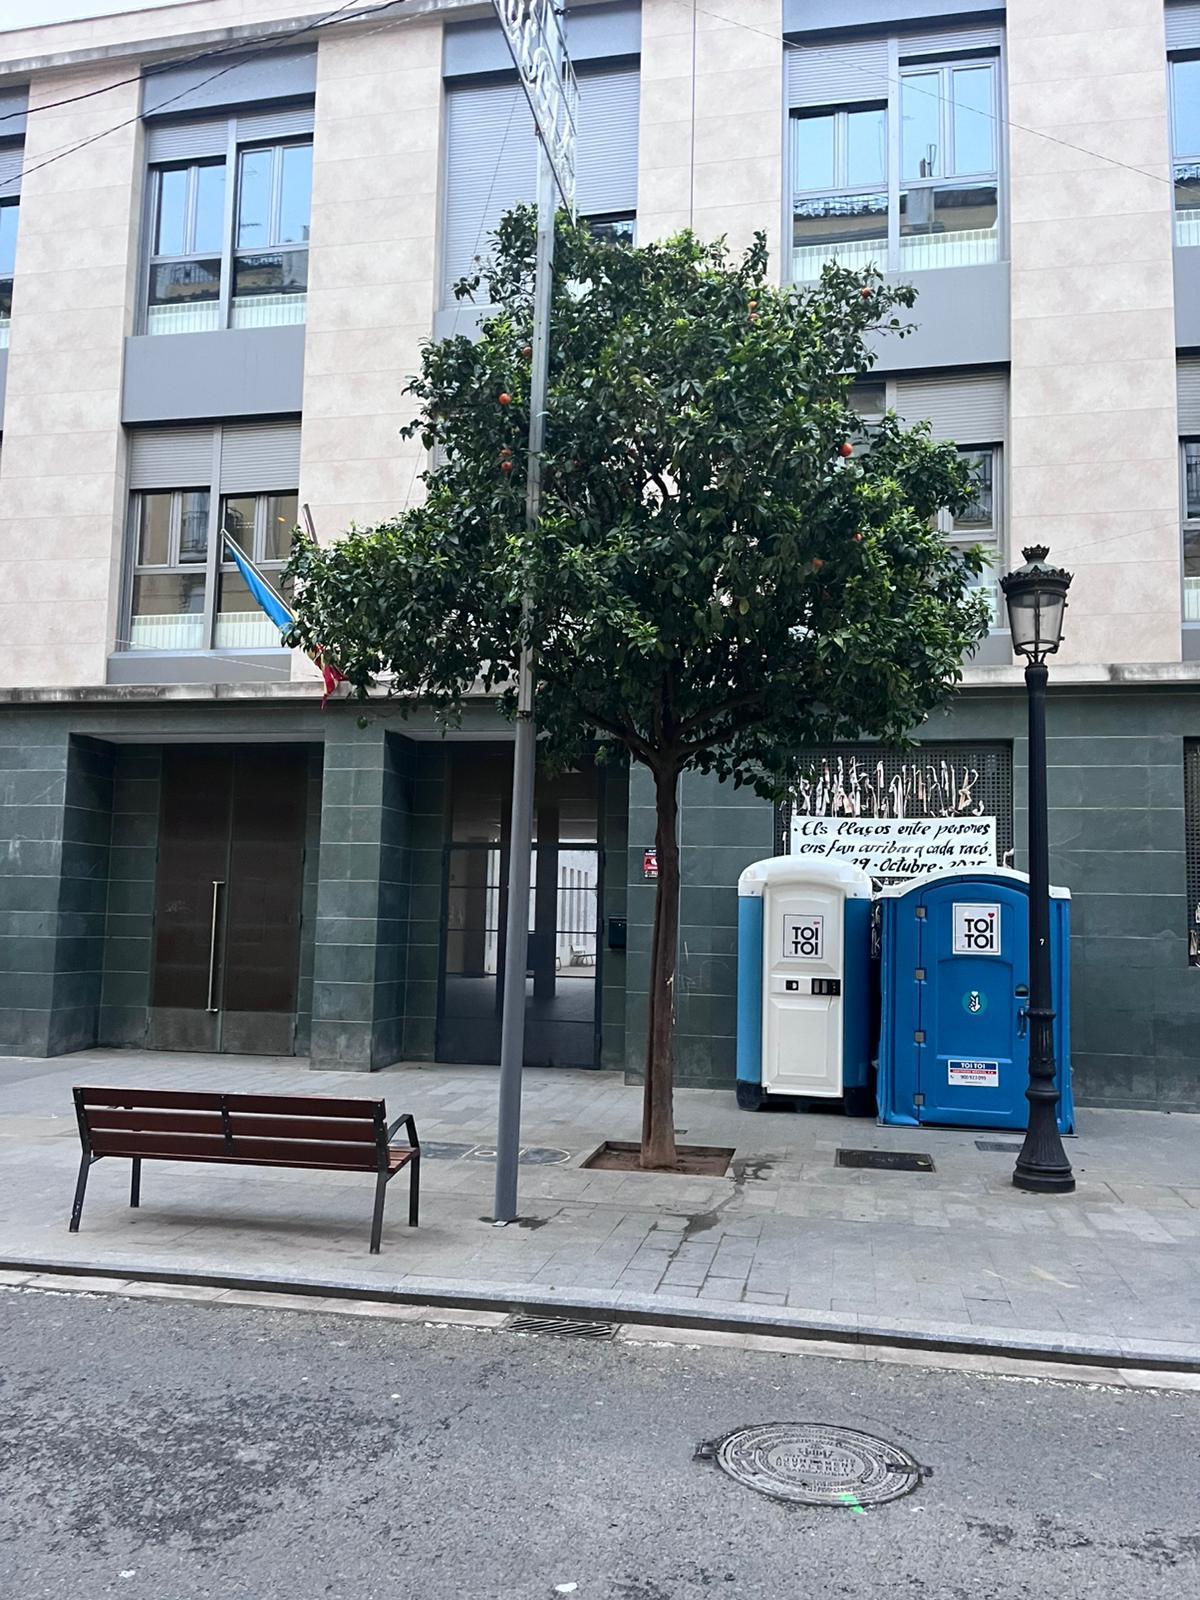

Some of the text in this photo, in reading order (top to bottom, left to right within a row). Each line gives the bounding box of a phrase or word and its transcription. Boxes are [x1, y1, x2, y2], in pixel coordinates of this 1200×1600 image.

[801, 821, 991, 840] Els llaços entre persones
[800, 844, 827, 854] ens
[825, 839, 856, 857] fan
[858, 840, 915, 854] arribar
[926, 839, 955, 856] cada
[879, 856, 937, 874] Octubre
[964, 918, 994, 933] TOI
[792, 926, 818, 941] TOI
[792, 941, 818, 956] TOI
[964, 934, 994, 949] TOI
